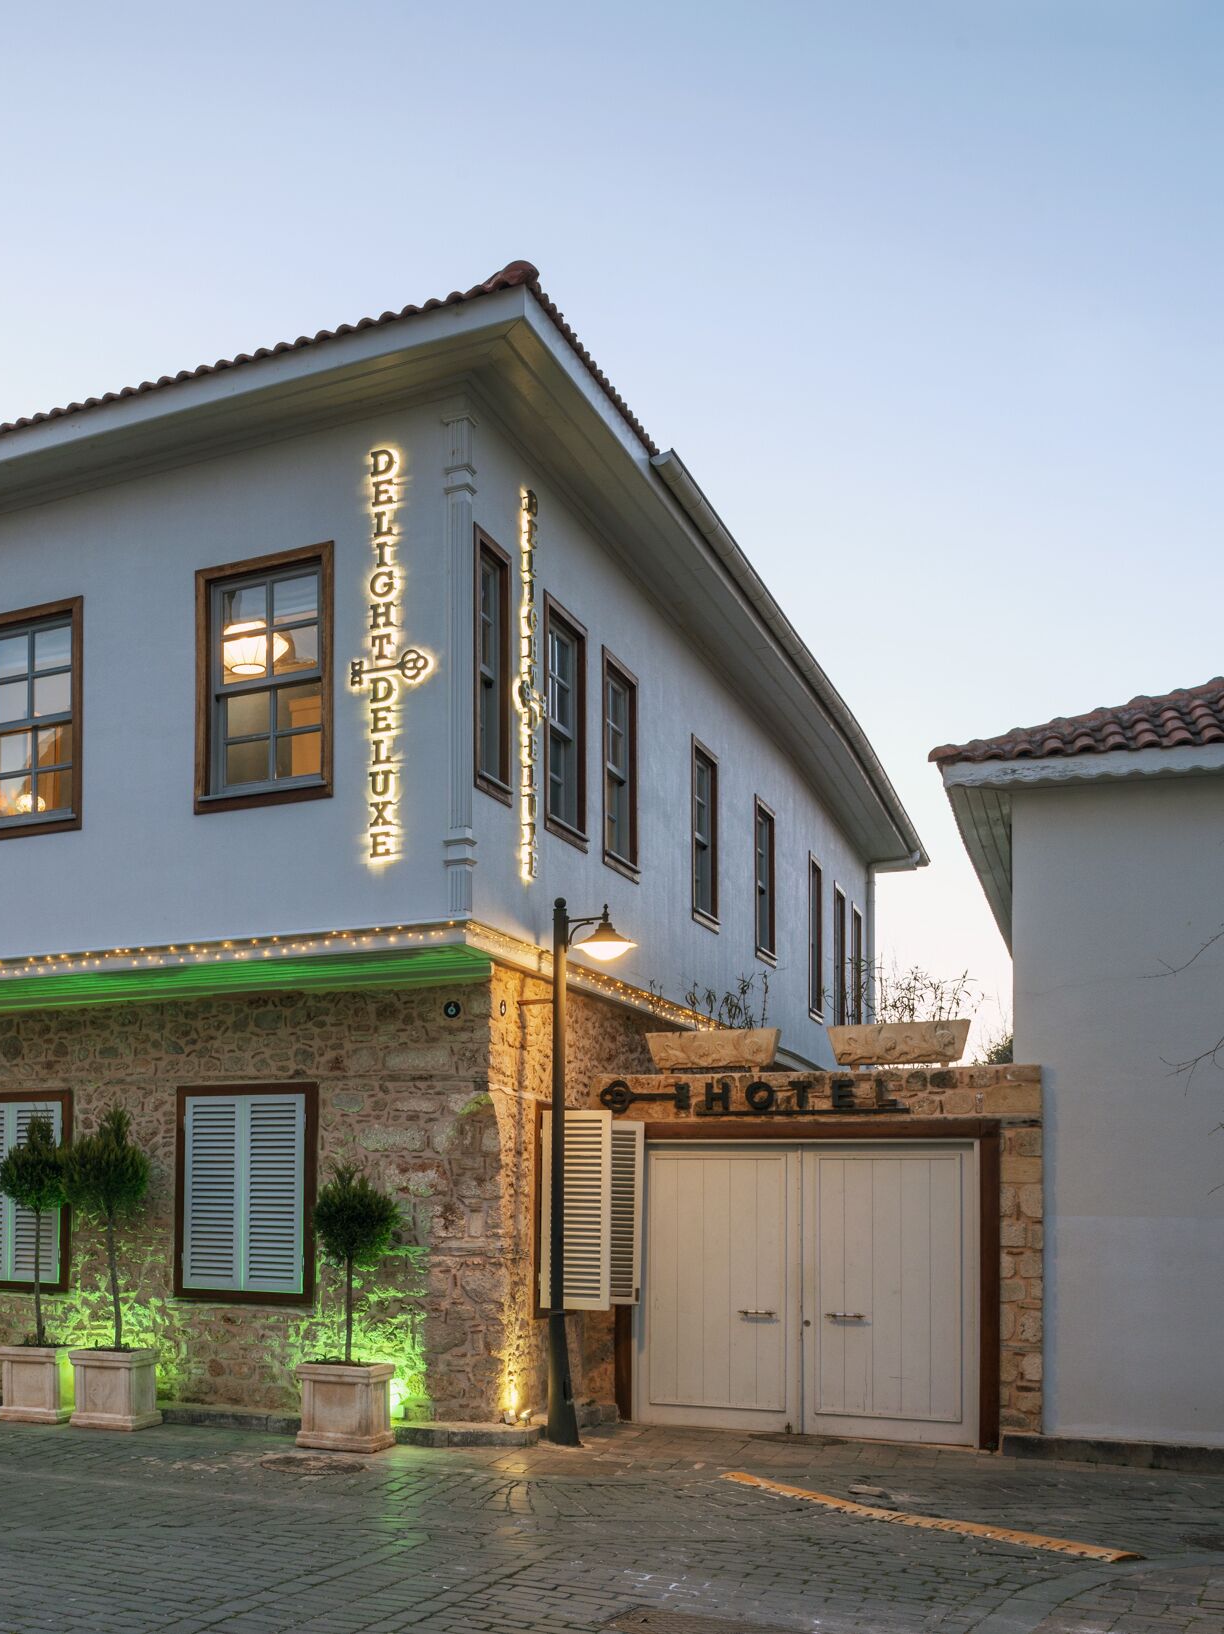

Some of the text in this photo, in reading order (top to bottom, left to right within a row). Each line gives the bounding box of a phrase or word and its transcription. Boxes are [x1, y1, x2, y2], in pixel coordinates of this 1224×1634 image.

[369, 449, 397, 859] DELIGHT DELUXE
[705, 1079, 897, 1111] HOTEL
